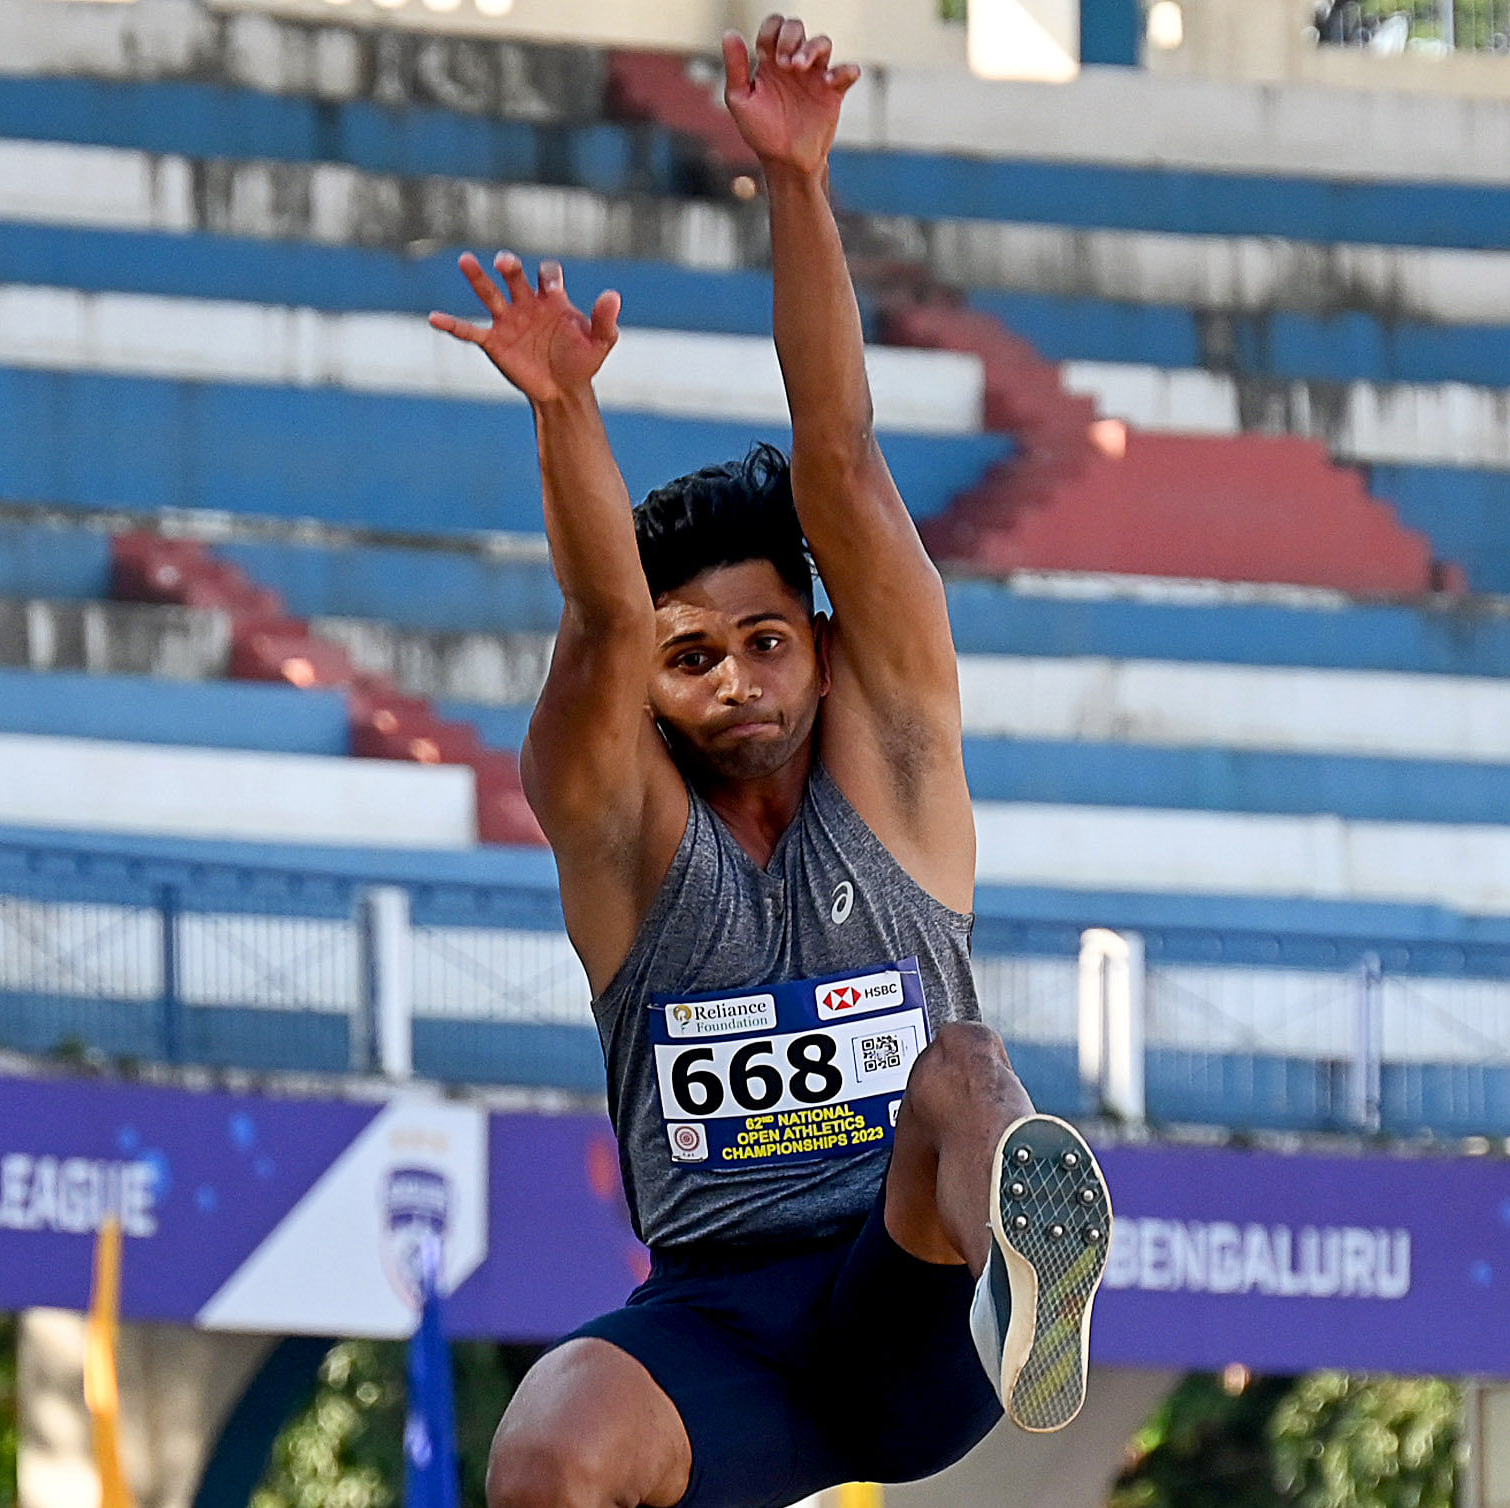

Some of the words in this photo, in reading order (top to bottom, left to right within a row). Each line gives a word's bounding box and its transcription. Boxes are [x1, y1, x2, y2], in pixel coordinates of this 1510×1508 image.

[864, 983, 897, 999] HSBC
[694, 1001, 767, 1021] Reliance
[696, 1016, 768, 1033] Foundation
[671, 1033, 843, 1116] 668
[777, 1103, 855, 1127] NATIONAL
[721, 1132, 849, 1161] CHAMPIONSHIPS
[850, 1125, 885, 1145] 2023
[736, 1128, 781, 1146] OPEN
[782, 1114, 866, 1141] ATHLETICS
[1105, 1216, 1412, 1300] BENGALURU
